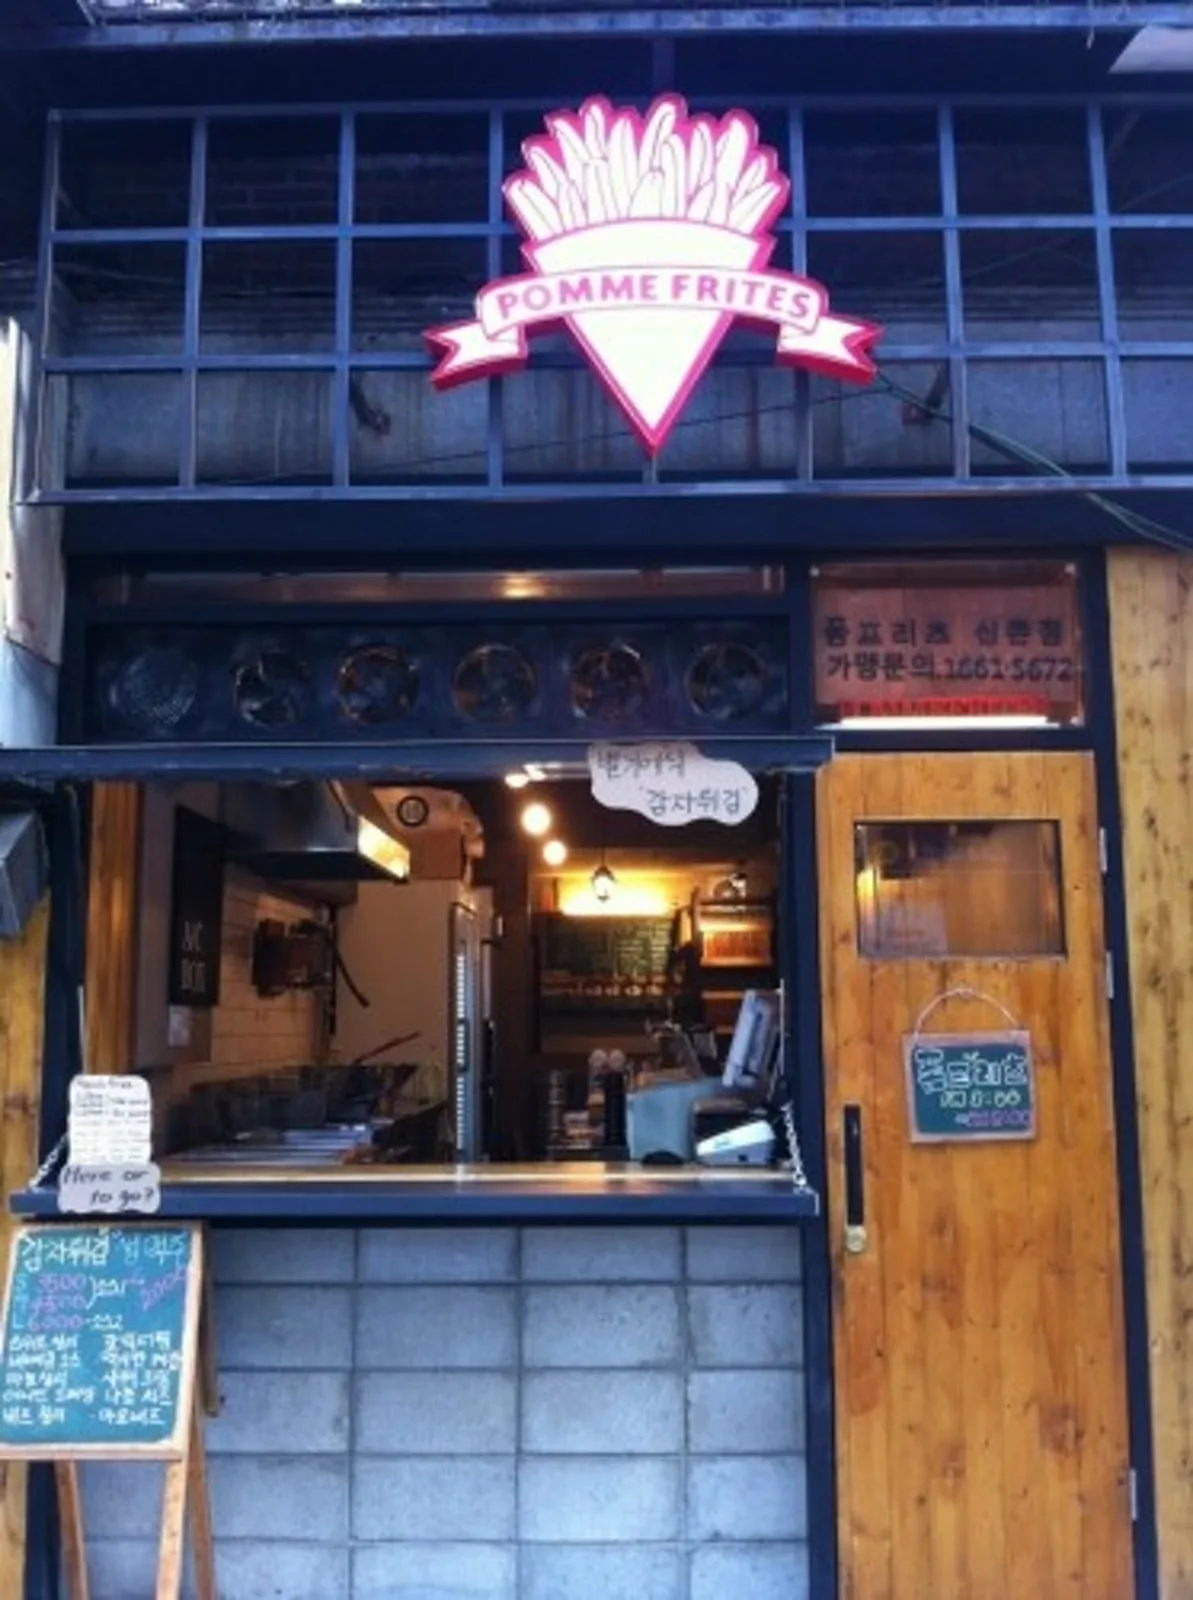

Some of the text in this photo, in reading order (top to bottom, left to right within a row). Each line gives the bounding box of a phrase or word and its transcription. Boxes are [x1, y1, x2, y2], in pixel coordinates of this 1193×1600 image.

[495, 274, 810, 320] POMME FRITES
[64, 1167, 148, 1184] Here or
